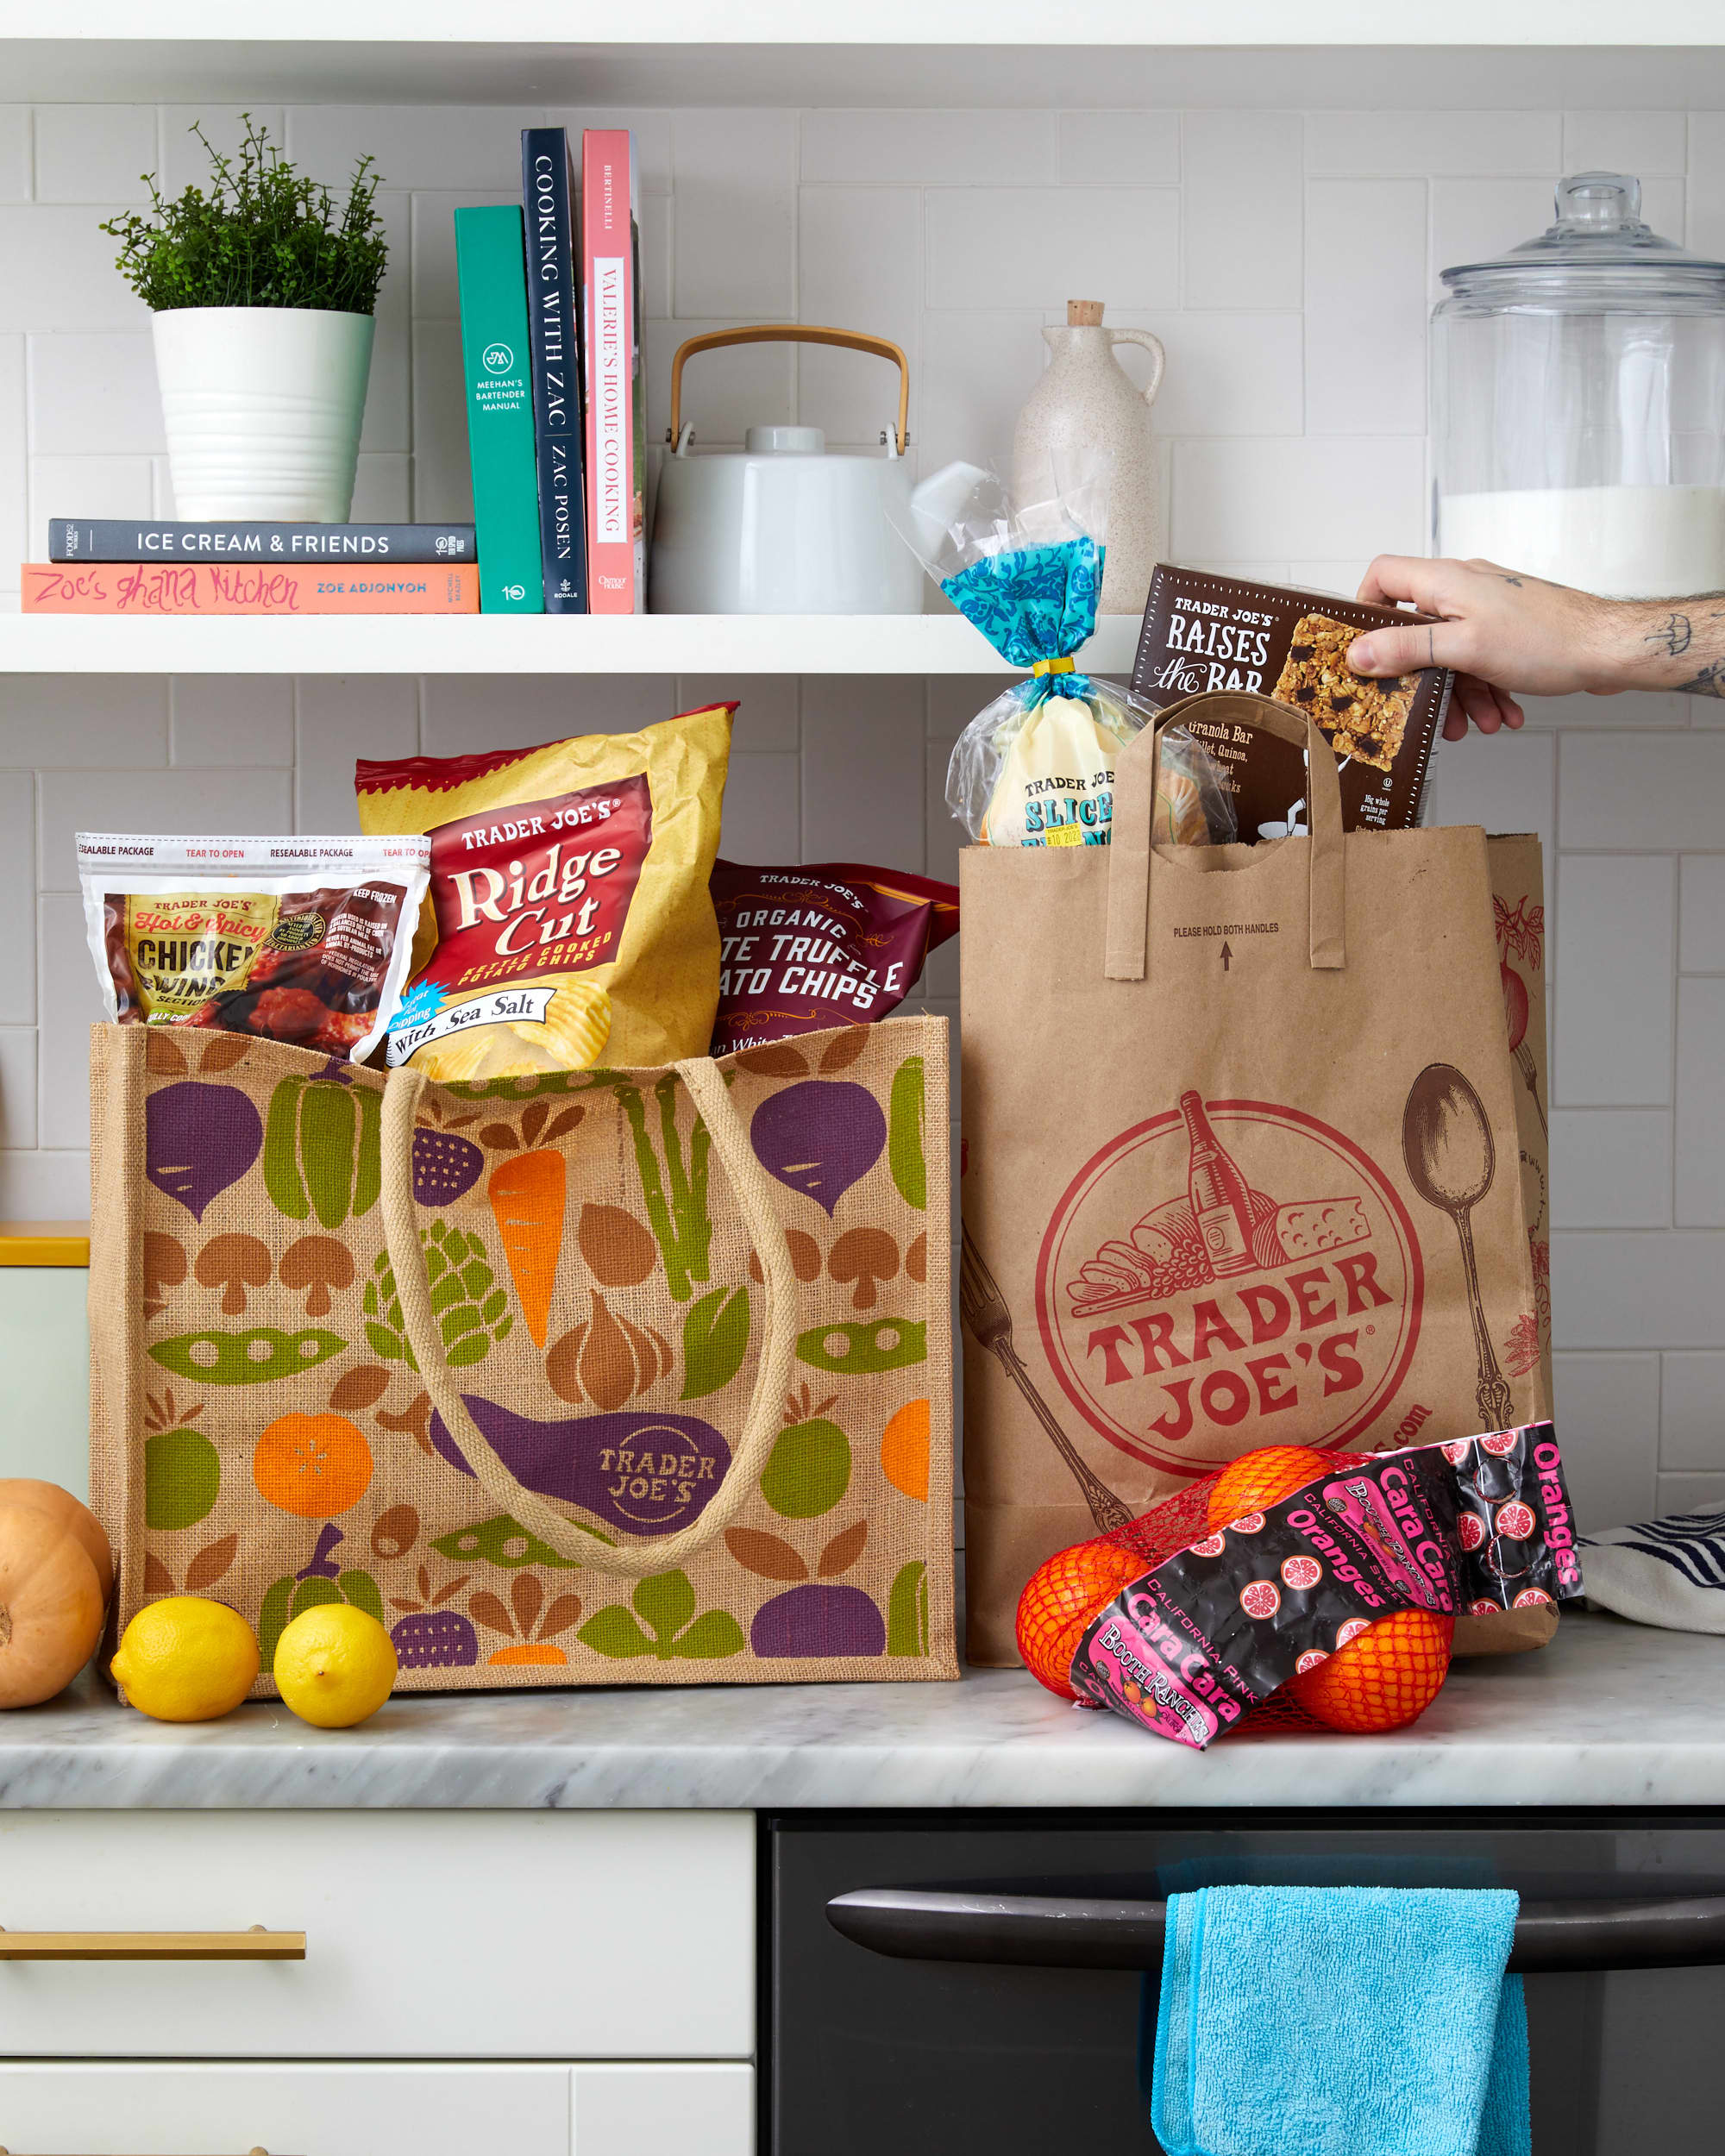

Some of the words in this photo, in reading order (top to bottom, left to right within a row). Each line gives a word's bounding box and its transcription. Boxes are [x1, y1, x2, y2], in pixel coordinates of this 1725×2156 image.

[536, 155, 559, 280] COOKING
[604, 165, 612, 229] BERTINELLI
[543, 291, 562, 361] WITH
[603, 269, 618, 367] VALERIE'S
[476, 391, 525, 400] BARTENDER
[477, 379, 523, 389] MEEHAN'S
[547, 372, 566, 426] ZAC
[604, 374, 618, 433] HOME
[482, 402, 520, 411] MANUAL
[552, 445, 568, 487] ZAC
[605, 439, 619, 531] COOKING
[137, 533, 174, 550] ICE
[181, 533, 262, 551] CREAM
[270, 535, 283, 552] &
[292, 535, 389, 553] FRIENDS
[555, 495, 571, 559] POSEN
[28, 571, 106, 602] Zoe's
[210, 567, 299, 611] Kitchen
[317, 582, 345, 593] ZOE
[349, 582, 426, 593] ADJONYOH
[1175, 597, 1229, 618] TRADER
[1232, 609, 1274, 626] JOE'S
[1165, 614, 1270, 666] RAISES
[1149, 657, 1208, 693] the
[1207, 662, 1263, 693] BAR
[1189, 721, 1229, 740] Granola
[1232, 725, 1253, 744] Bar
[1218, 744, 1248, 762] Quinoa,
[1025, 777, 1087, 797] TRADER
[1091, 771, 1115, 788] JOE
[461, 816, 546, 850] TRADER
[551, 799, 612, 830] JOE'S
[1026, 792, 1113, 832] SLICE
[1365, 815, 1386, 825] serving
[118, 846, 154, 856] PACKAGE
[223, 849, 244, 858] OPEN
[270, 849, 317, 857] RESEALABLE
[320, 849, 353, 857] PACKAGE
[154, 900, 207, 911] TRADER
[212, 899, 254, 912] JOE'S
[353, 889, 370, 899] KEEP
[371, 891, 397, 904] FROZEN
[448, 843, 624, 931] Ridge
[760, 874, 821, 887] TRADER
[824, 882, 864, 910] JOE'S
[135, 912, 184, 932] Hot
[185, 913, 204, 931] &
[206, 912, 267, 943] Spicy
[495, 897, 601, 956] Cut
[737, 910, 846, 938] ORGANIC
[1174, 927, 1201, 937] PLEASE
[1202, 925, 1221, 936] HOLD
[1224, 924, 1243, 935] BOTH
[1245, 923, 1279, 934] HANDLES
[457, 962, 528, 987] POTATO
[537, 950, 595, 967] CHIPS
[464, 954, 532, 976] KETTLE
[540, 931, 612, 956] COOKED
[769, 935, 904, 993] TRUFFLE
[154, 975, 226, 997] WIN
[157, 994, 207, 1006] SECTIO
[778, 967, 878, 1009] CHIPS
[446, 1006, 481, 1030] Sea
[491, 993, 534, 1016] Salt
[1087, 1252, 1394, 1386] TRADER
[1147, 1329, 1364, 1441] JOE'S
[599, 1449, 717, 1479] TRADER
[607, 1476, 697, 1503] JOE'S
[1404, 1458, 1451, 1560] CALIFORNIA
[1534, 1442, 1578, 1585] Oranges
[1287, 1510, 1386, 1608] Oranges
[1304, 1493, 1367, 1560] CALIFORNIA
[1370, 1564, 1408, 1606] SWEET
[1380, 1467, 1424, 1539] Cara
[1415, 1540, 1453, 1612] Cara
[1127, 1592, 1183, 1661] Cara
[1180, 1653, 1242, 1723] Cara
[1146, 1578, 1221, 1664] CALIFORNIA
[1223, 1664, 1259, 1704] PINK
[1099, 1623, 1152, 1684] BOOTH
[1145, 1670, 1210, 1745] RANCHES
